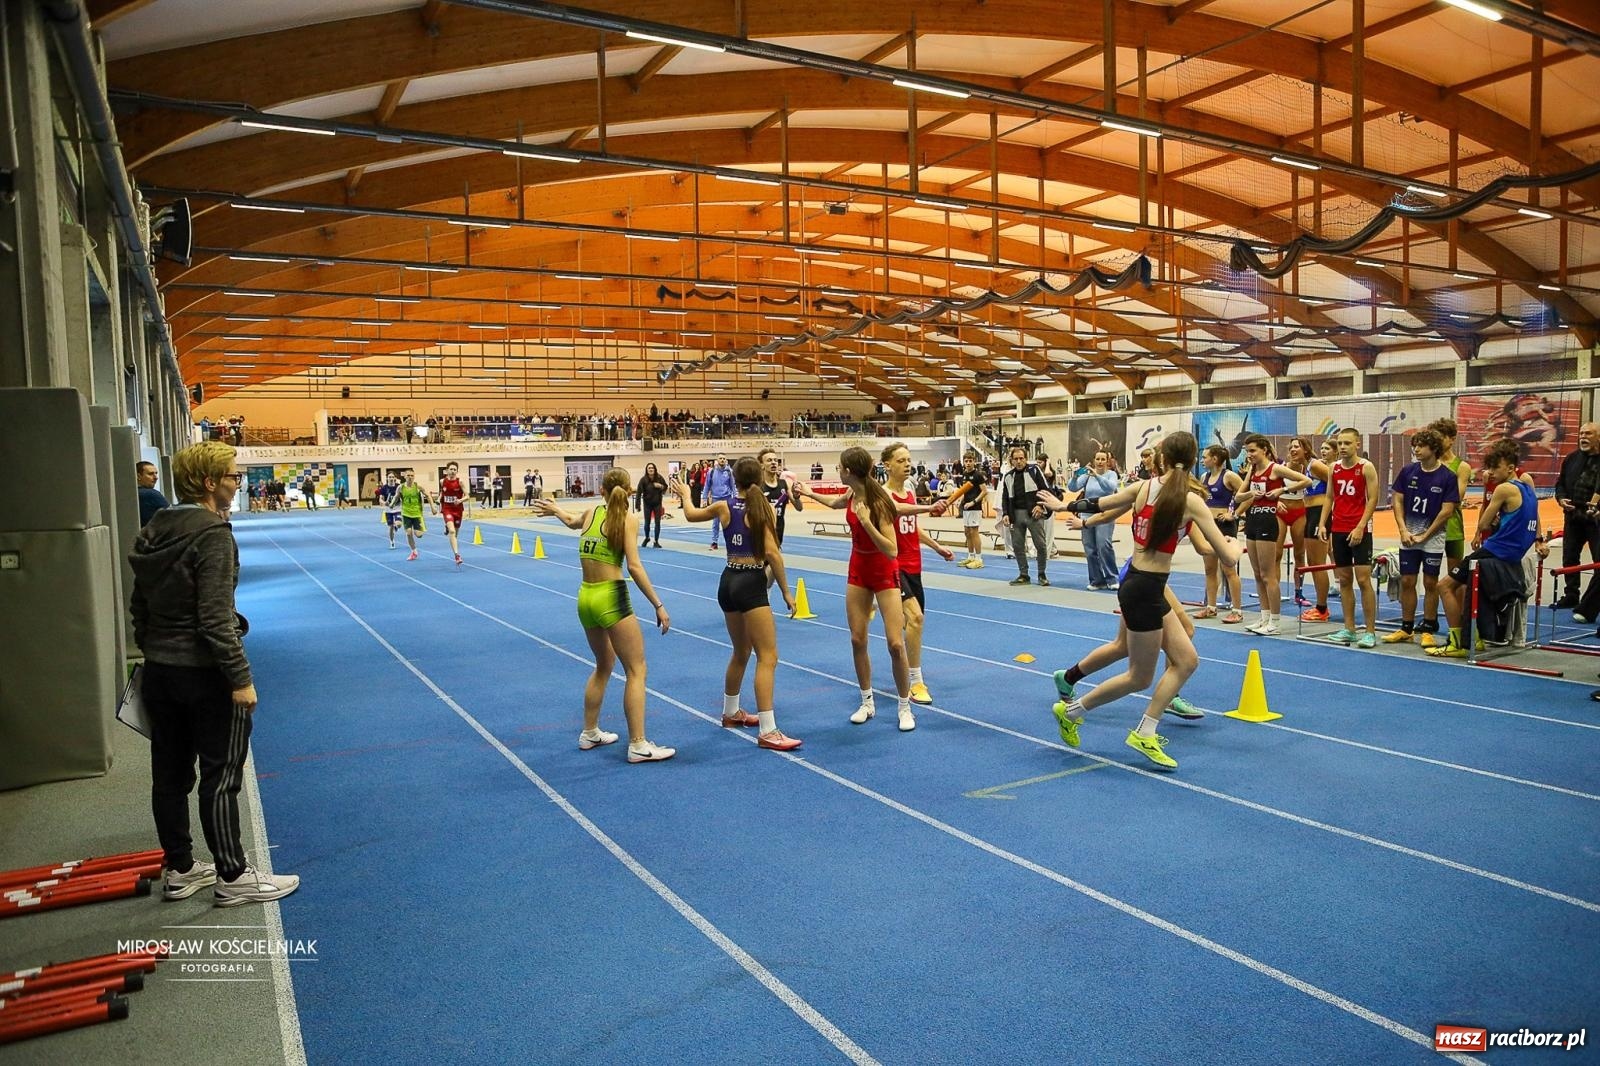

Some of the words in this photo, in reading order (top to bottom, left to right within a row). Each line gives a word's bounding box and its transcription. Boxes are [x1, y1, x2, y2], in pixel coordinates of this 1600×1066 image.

[1337, 479, 1356, 496] 76
[1412, 496, 1428, 514] 21
[898, 515, 916, 534] 63
[583, 540, 597, 554] 67
[731, 534, 743, 546] 49
